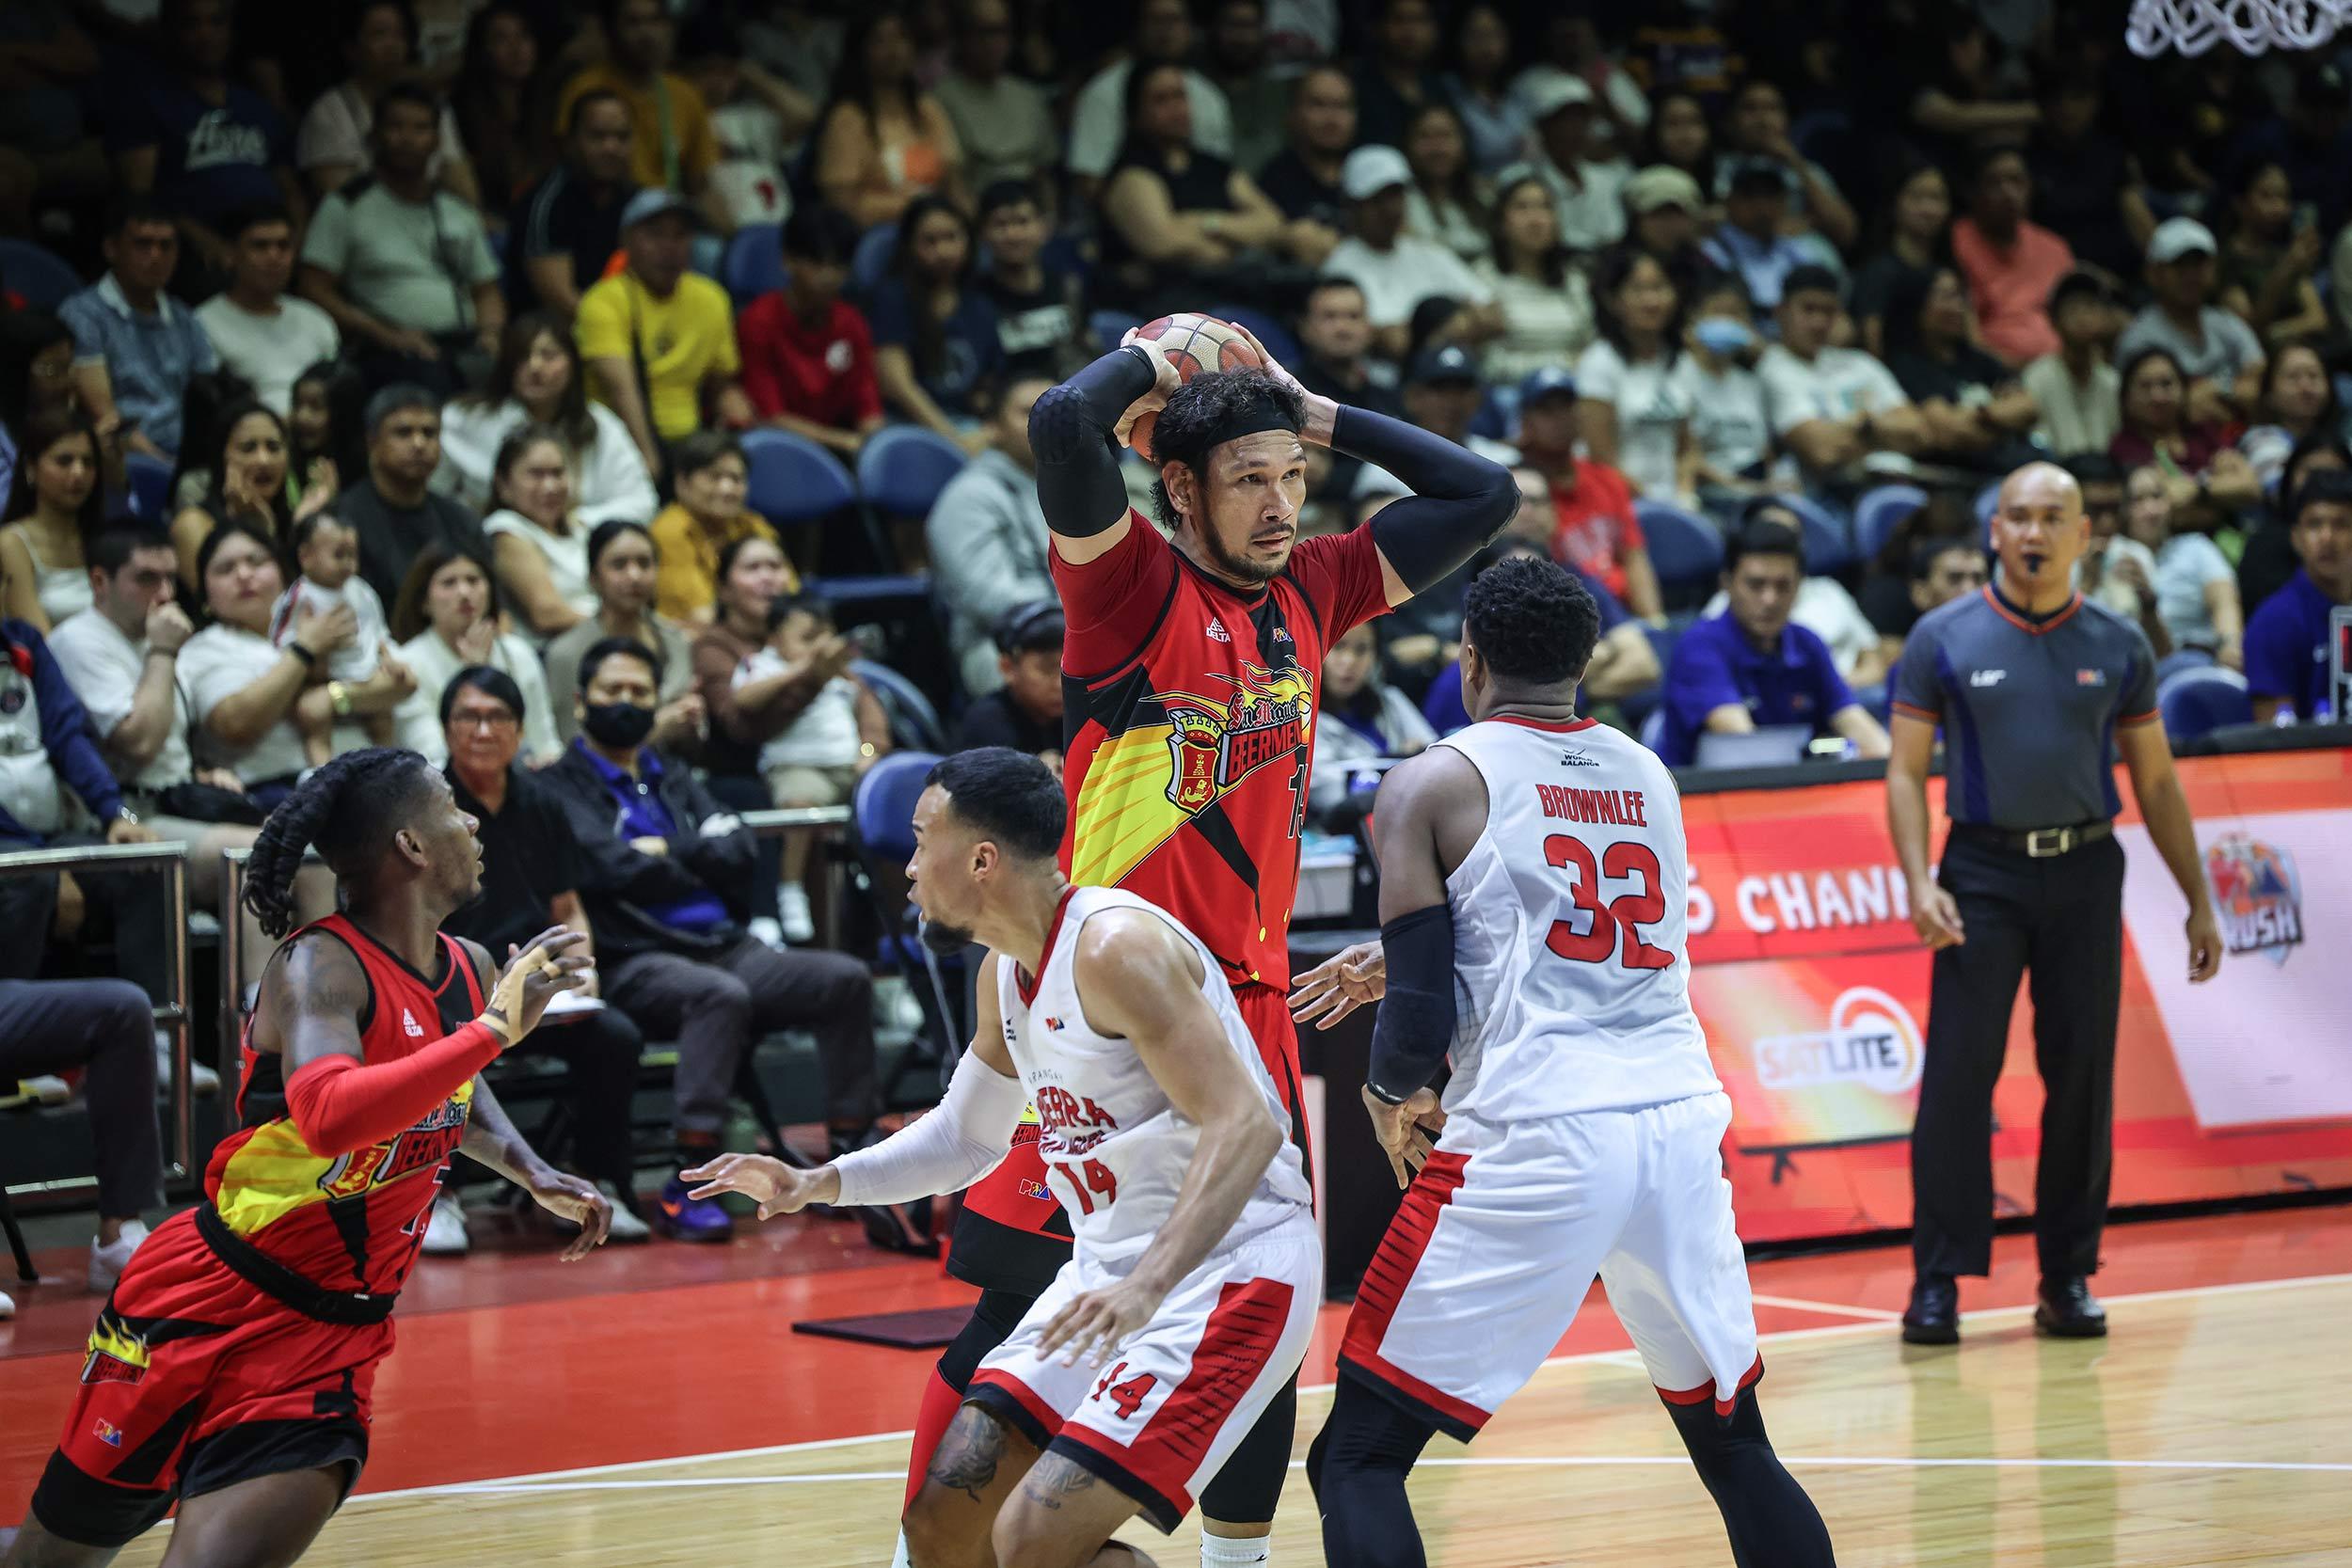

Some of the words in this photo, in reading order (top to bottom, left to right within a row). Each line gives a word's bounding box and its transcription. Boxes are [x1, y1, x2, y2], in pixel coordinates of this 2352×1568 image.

[1206, 626, 1231, 642] DELTA
[1228, 720, 1302, 783] BEERMEN
[1535, 784, 1646, 827] BROWNLEE
[1543, 833, 1676, 971] 32
[1019, 1178, 1051, 1201] PBA
[1054, 1158, 1118, 1216] 14
